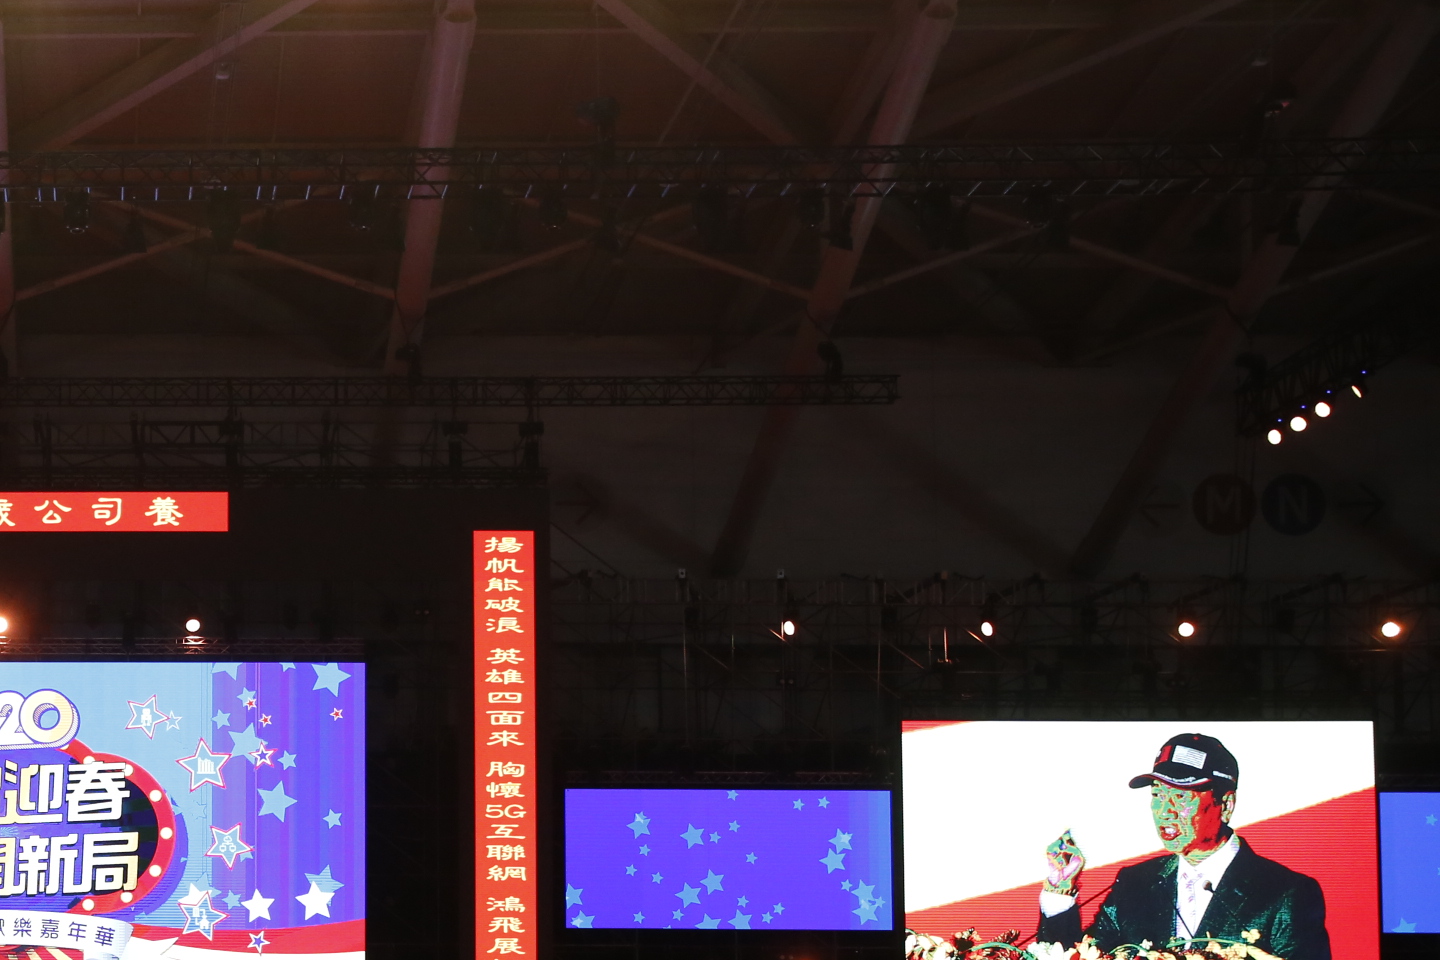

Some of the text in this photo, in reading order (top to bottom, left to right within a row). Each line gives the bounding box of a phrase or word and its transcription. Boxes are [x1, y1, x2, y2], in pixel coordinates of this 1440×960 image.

[1206, 484, 1308, 525] M N
[484, 536, 525, 634] 揚帆能破浪
[484, 647, 525, 747] 英雄四面來
[485, 761, 527, 882] 胸懷5G互聯網
